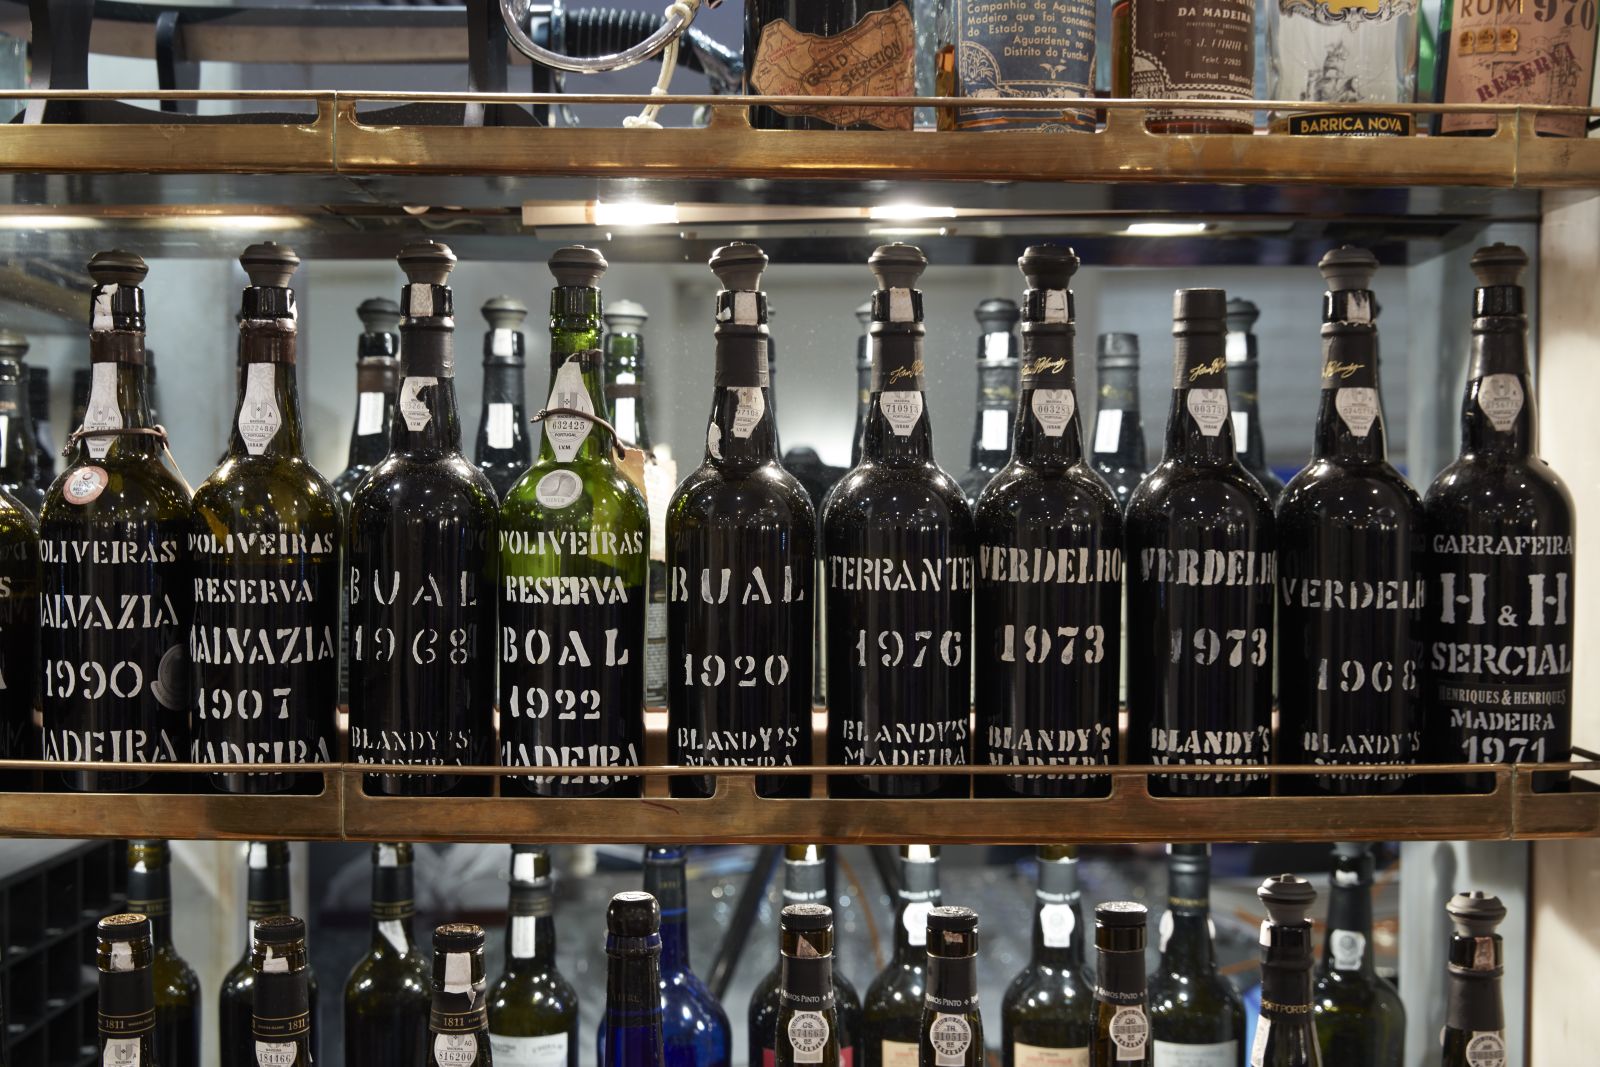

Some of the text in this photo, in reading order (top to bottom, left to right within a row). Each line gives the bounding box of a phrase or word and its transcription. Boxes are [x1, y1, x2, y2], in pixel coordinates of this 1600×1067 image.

[967, 2, 1026, 14] Companhia
[967, 13, 1008, 25] Madeira
[1016, 13, 1035, 23] que
[1043, 11, 1055, 22] foi
[1177, 7, 1251, 24] DA MADEIRA
[989, 24, 1024, 34] Estado
[1034, 26, 1057, 35] para
[1013, 35, 1084, 49] Aguardente no
[842, 40, 902, 88] SELECTION
[1004, 47, 1088, 62] Distrito do Funchal
[807, 54, 848, 87] GOLD
[1185, 71, 1219, 80] Funchal
[1475, 43, 1577, 102] RESERVA
[1300, 117, 1402, 133] BARRICA NOVA
[552, 420, 585, 430] 632425
[1433, 534, 1575, 556] GARRAFEIRA
[980, 544, 1121, 584] VERDELHO
[194, 577, 313, 604] RESERVA
[350, 566, 477, 607] BUAL
[506, 575, 628, 604] RESERVA
[671, 565, 804, 605] BUAL
[1440, 572, 1568, 627] H & H
[355, 625, 468, 664] 1968
[504, 626, 628, 667] BOAL
[856, 629, 962, 668] 1976
[1001, 624, 1105, 664] 1973
[1170, 627, 1267, 668] 1973
[684, 653, 789, 687] 1920
[1431, 642, 1571, 676] SERCIAL
[46, 659, 143, 700] 1990
[1317, 658, 1417, 692] 1968
[199, 687, 291, 720] 1907
[509, 685, 600, 720] 1922
[1501, 689, 1512, 706] &
[1513, 690, 1566, 705] HENRIQUES
[843, 718, 968, 744] BLANDY'S
[1450, 708, 1555, 731] MADEIRA
[42, 727, 177, 762] ADEIRA
[678, 726, 799, 751] BLANDY'S
[988, 723, 1111, 751] BLANDY'S
[1151, 725, 1269, 754] BLANDY'S
[1461, 735, 1545, 763] 1971
[801, 995, 820, 1003] PINTO
[943, 998, 962, 1007] PINTO
[105, 1019, 124, 1029] 1811
[288, 1018, 305, 1031] 1811
[443, 1017, 464, 1027] 1811
